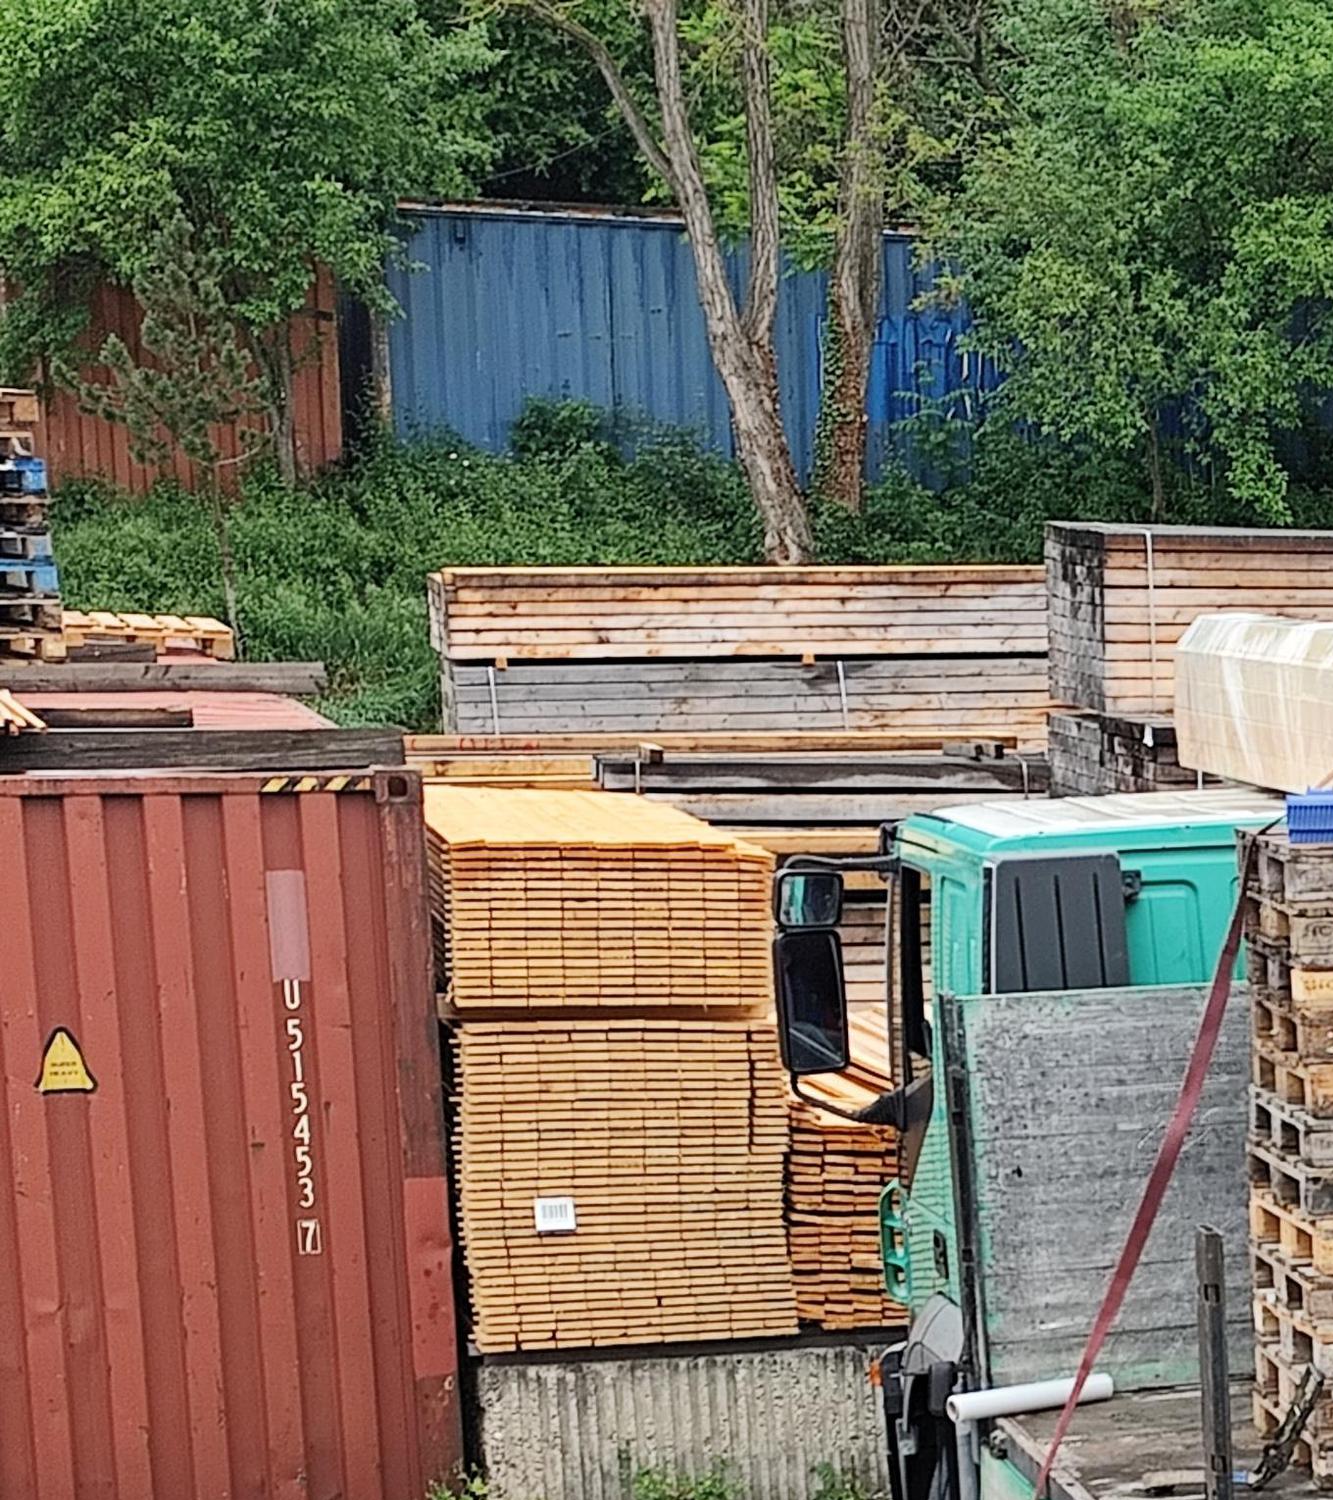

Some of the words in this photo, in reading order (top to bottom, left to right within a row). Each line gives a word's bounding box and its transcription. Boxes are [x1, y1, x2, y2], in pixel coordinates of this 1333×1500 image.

[283, 978, 300, 1010] U
[286, 1018, 314, 1208] 515453
[300, 1220, 319, 1253] 7
